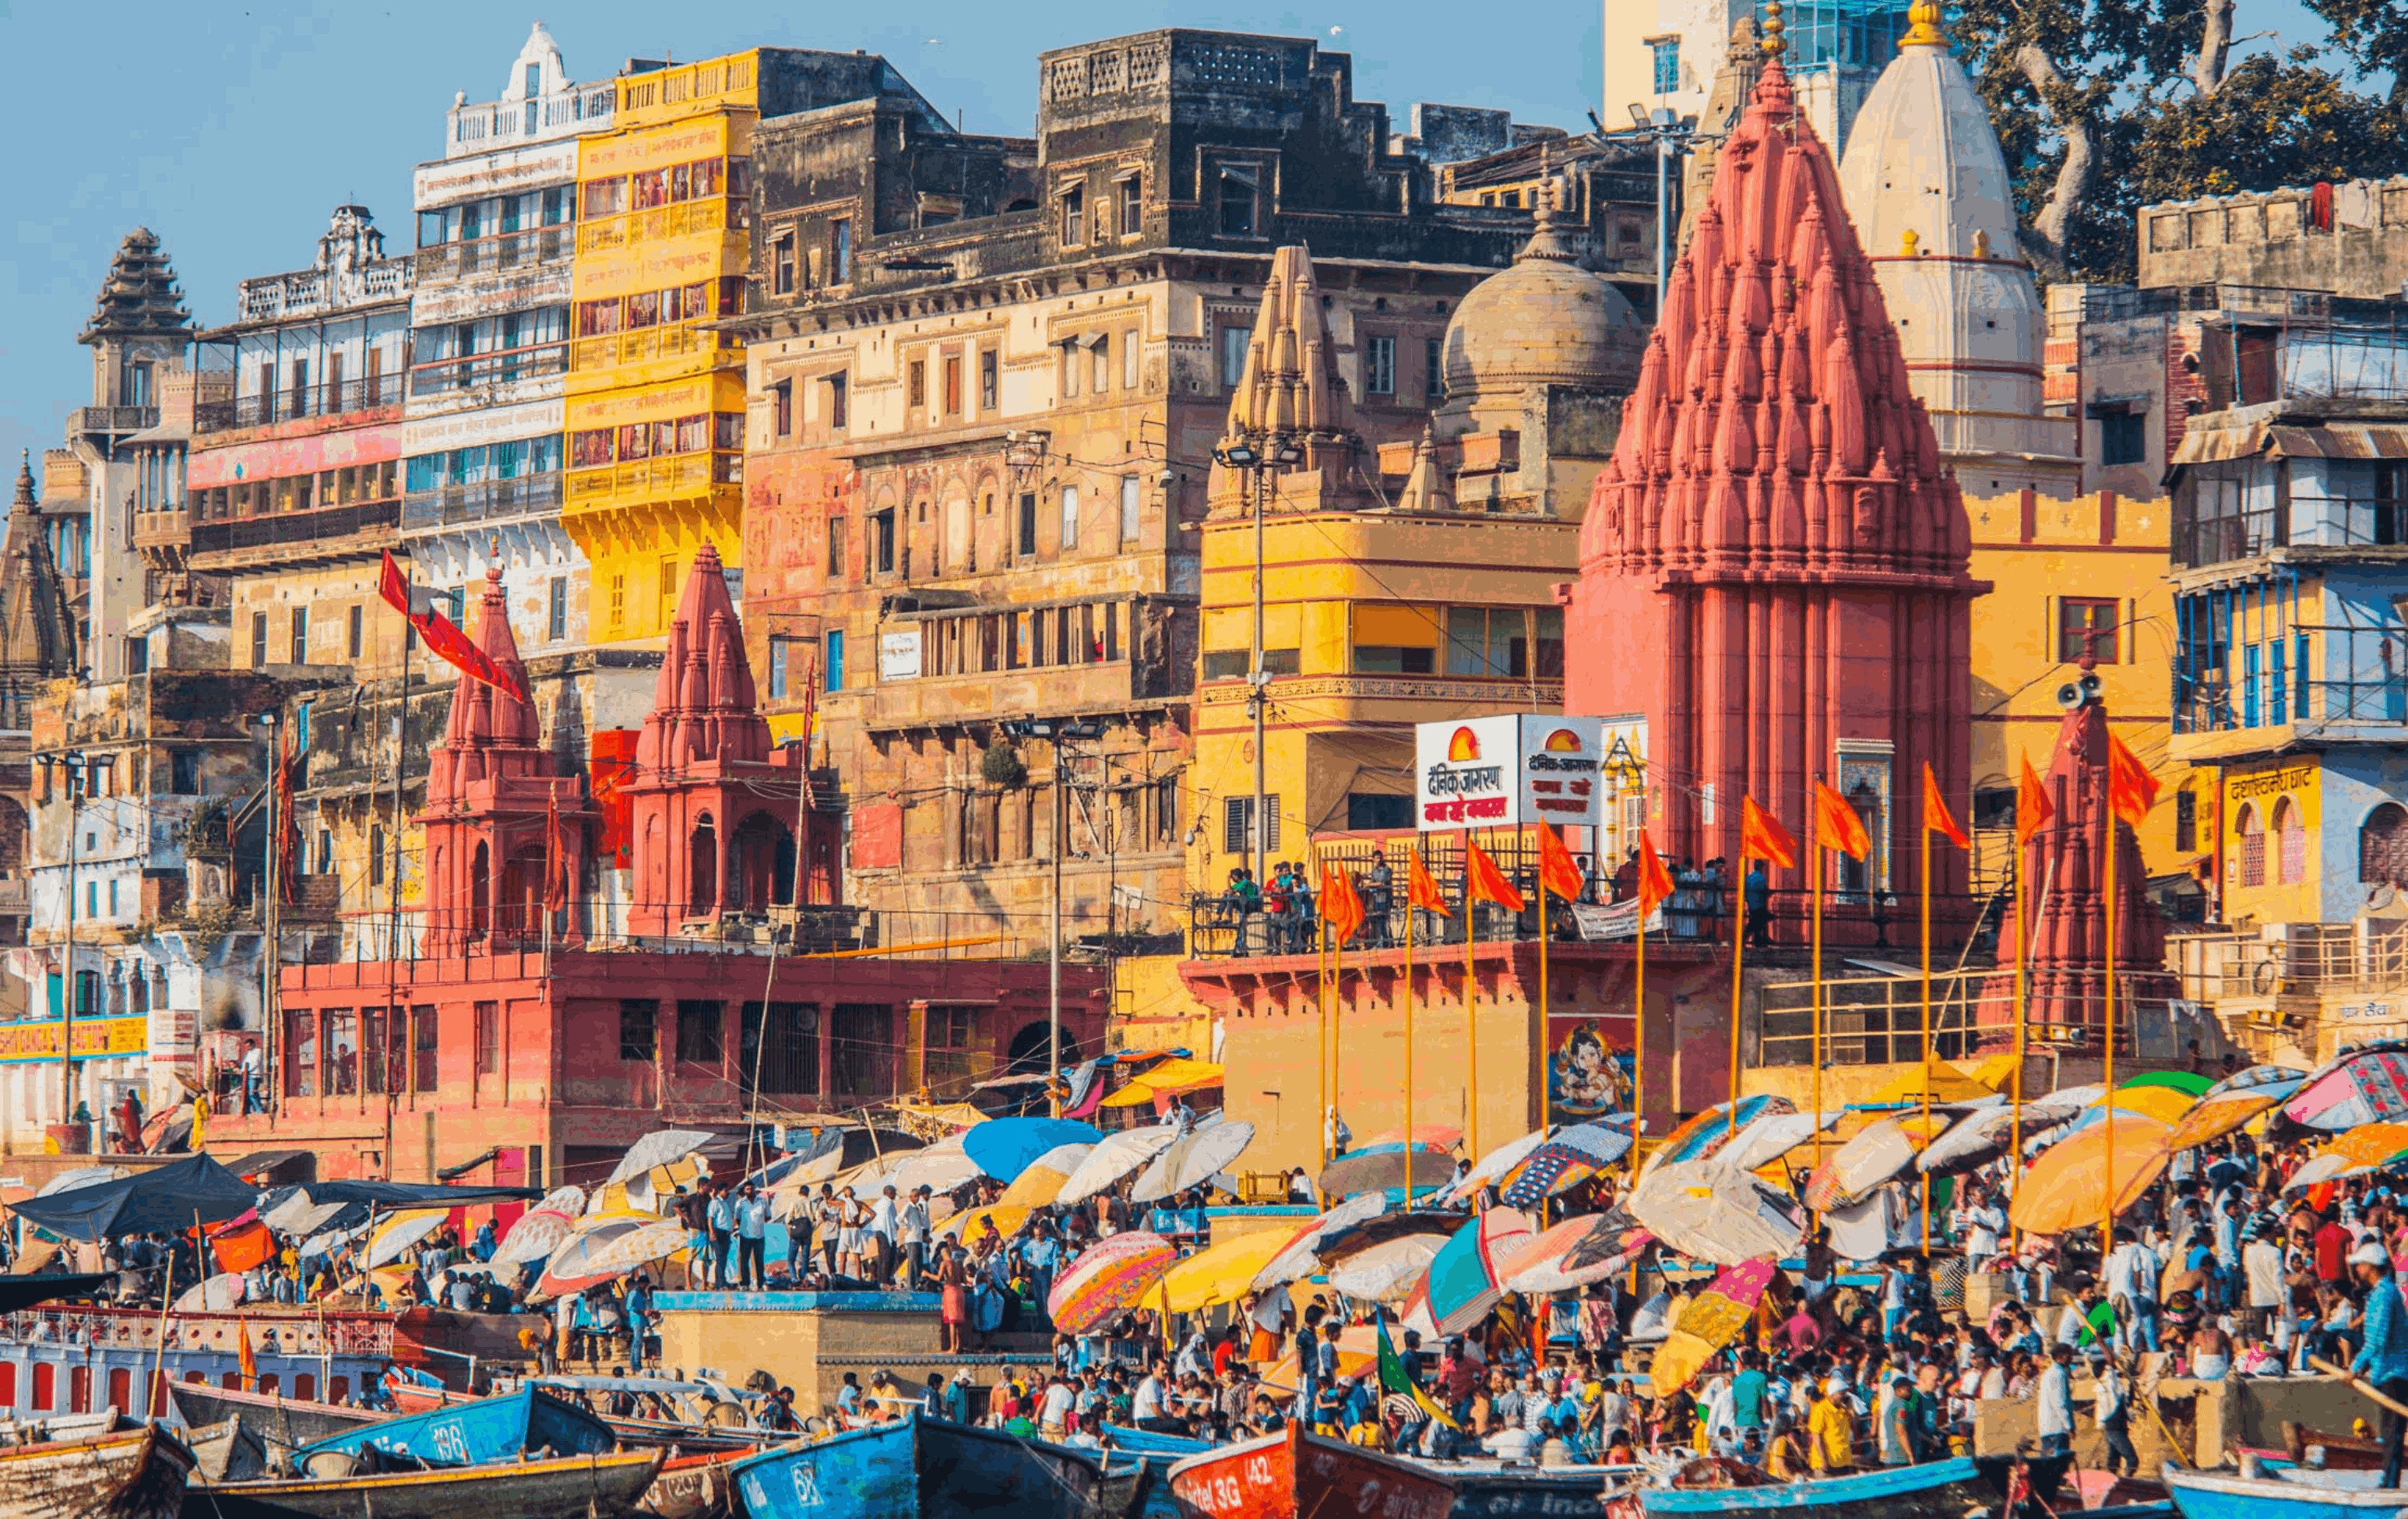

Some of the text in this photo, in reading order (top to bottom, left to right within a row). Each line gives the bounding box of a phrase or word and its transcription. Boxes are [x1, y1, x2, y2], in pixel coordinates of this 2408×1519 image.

[1428, 763, 1503, 796] दैनिक जागरण
[1529, 753, 1597, 774] दैनिक जागरण
[433, 1424, 466, 1461] 196
[1214, 1475, 1243, 1510] 3G
